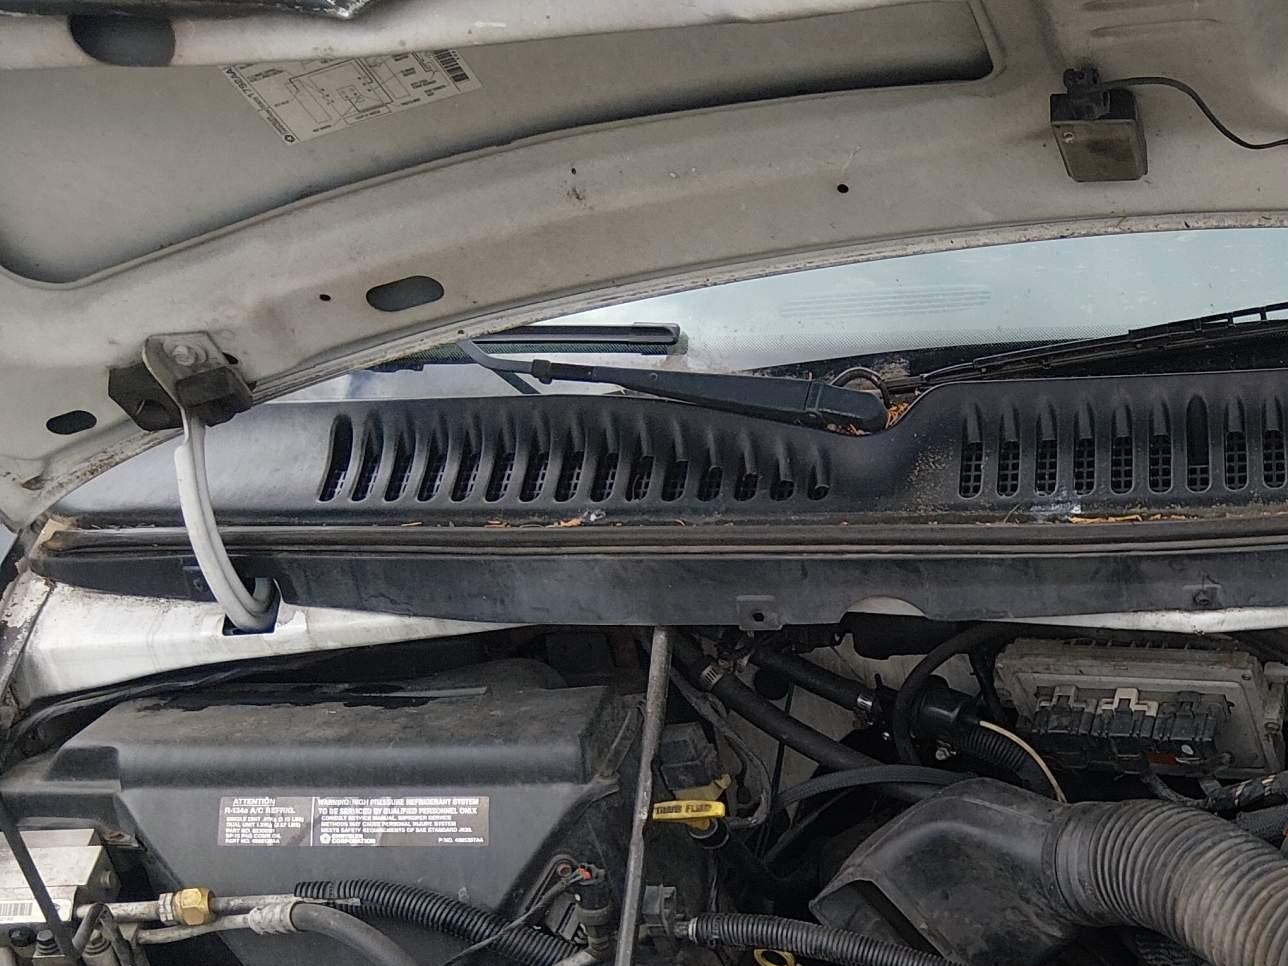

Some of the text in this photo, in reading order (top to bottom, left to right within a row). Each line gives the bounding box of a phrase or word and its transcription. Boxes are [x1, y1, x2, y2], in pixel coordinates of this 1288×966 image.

[233, 798, 276, 806] ATTENTION
[250, 807, 263, 815] A/C
[318, 807, 328, 815] TO
[329, 807, 338, 815] BE
[373, 807, 383, 815] BY
[383, 807, 417, 815] QUALIFIED
[418, 807, 458, 815] PERSONNEL
[685, 804, 712, 813] FLUID
